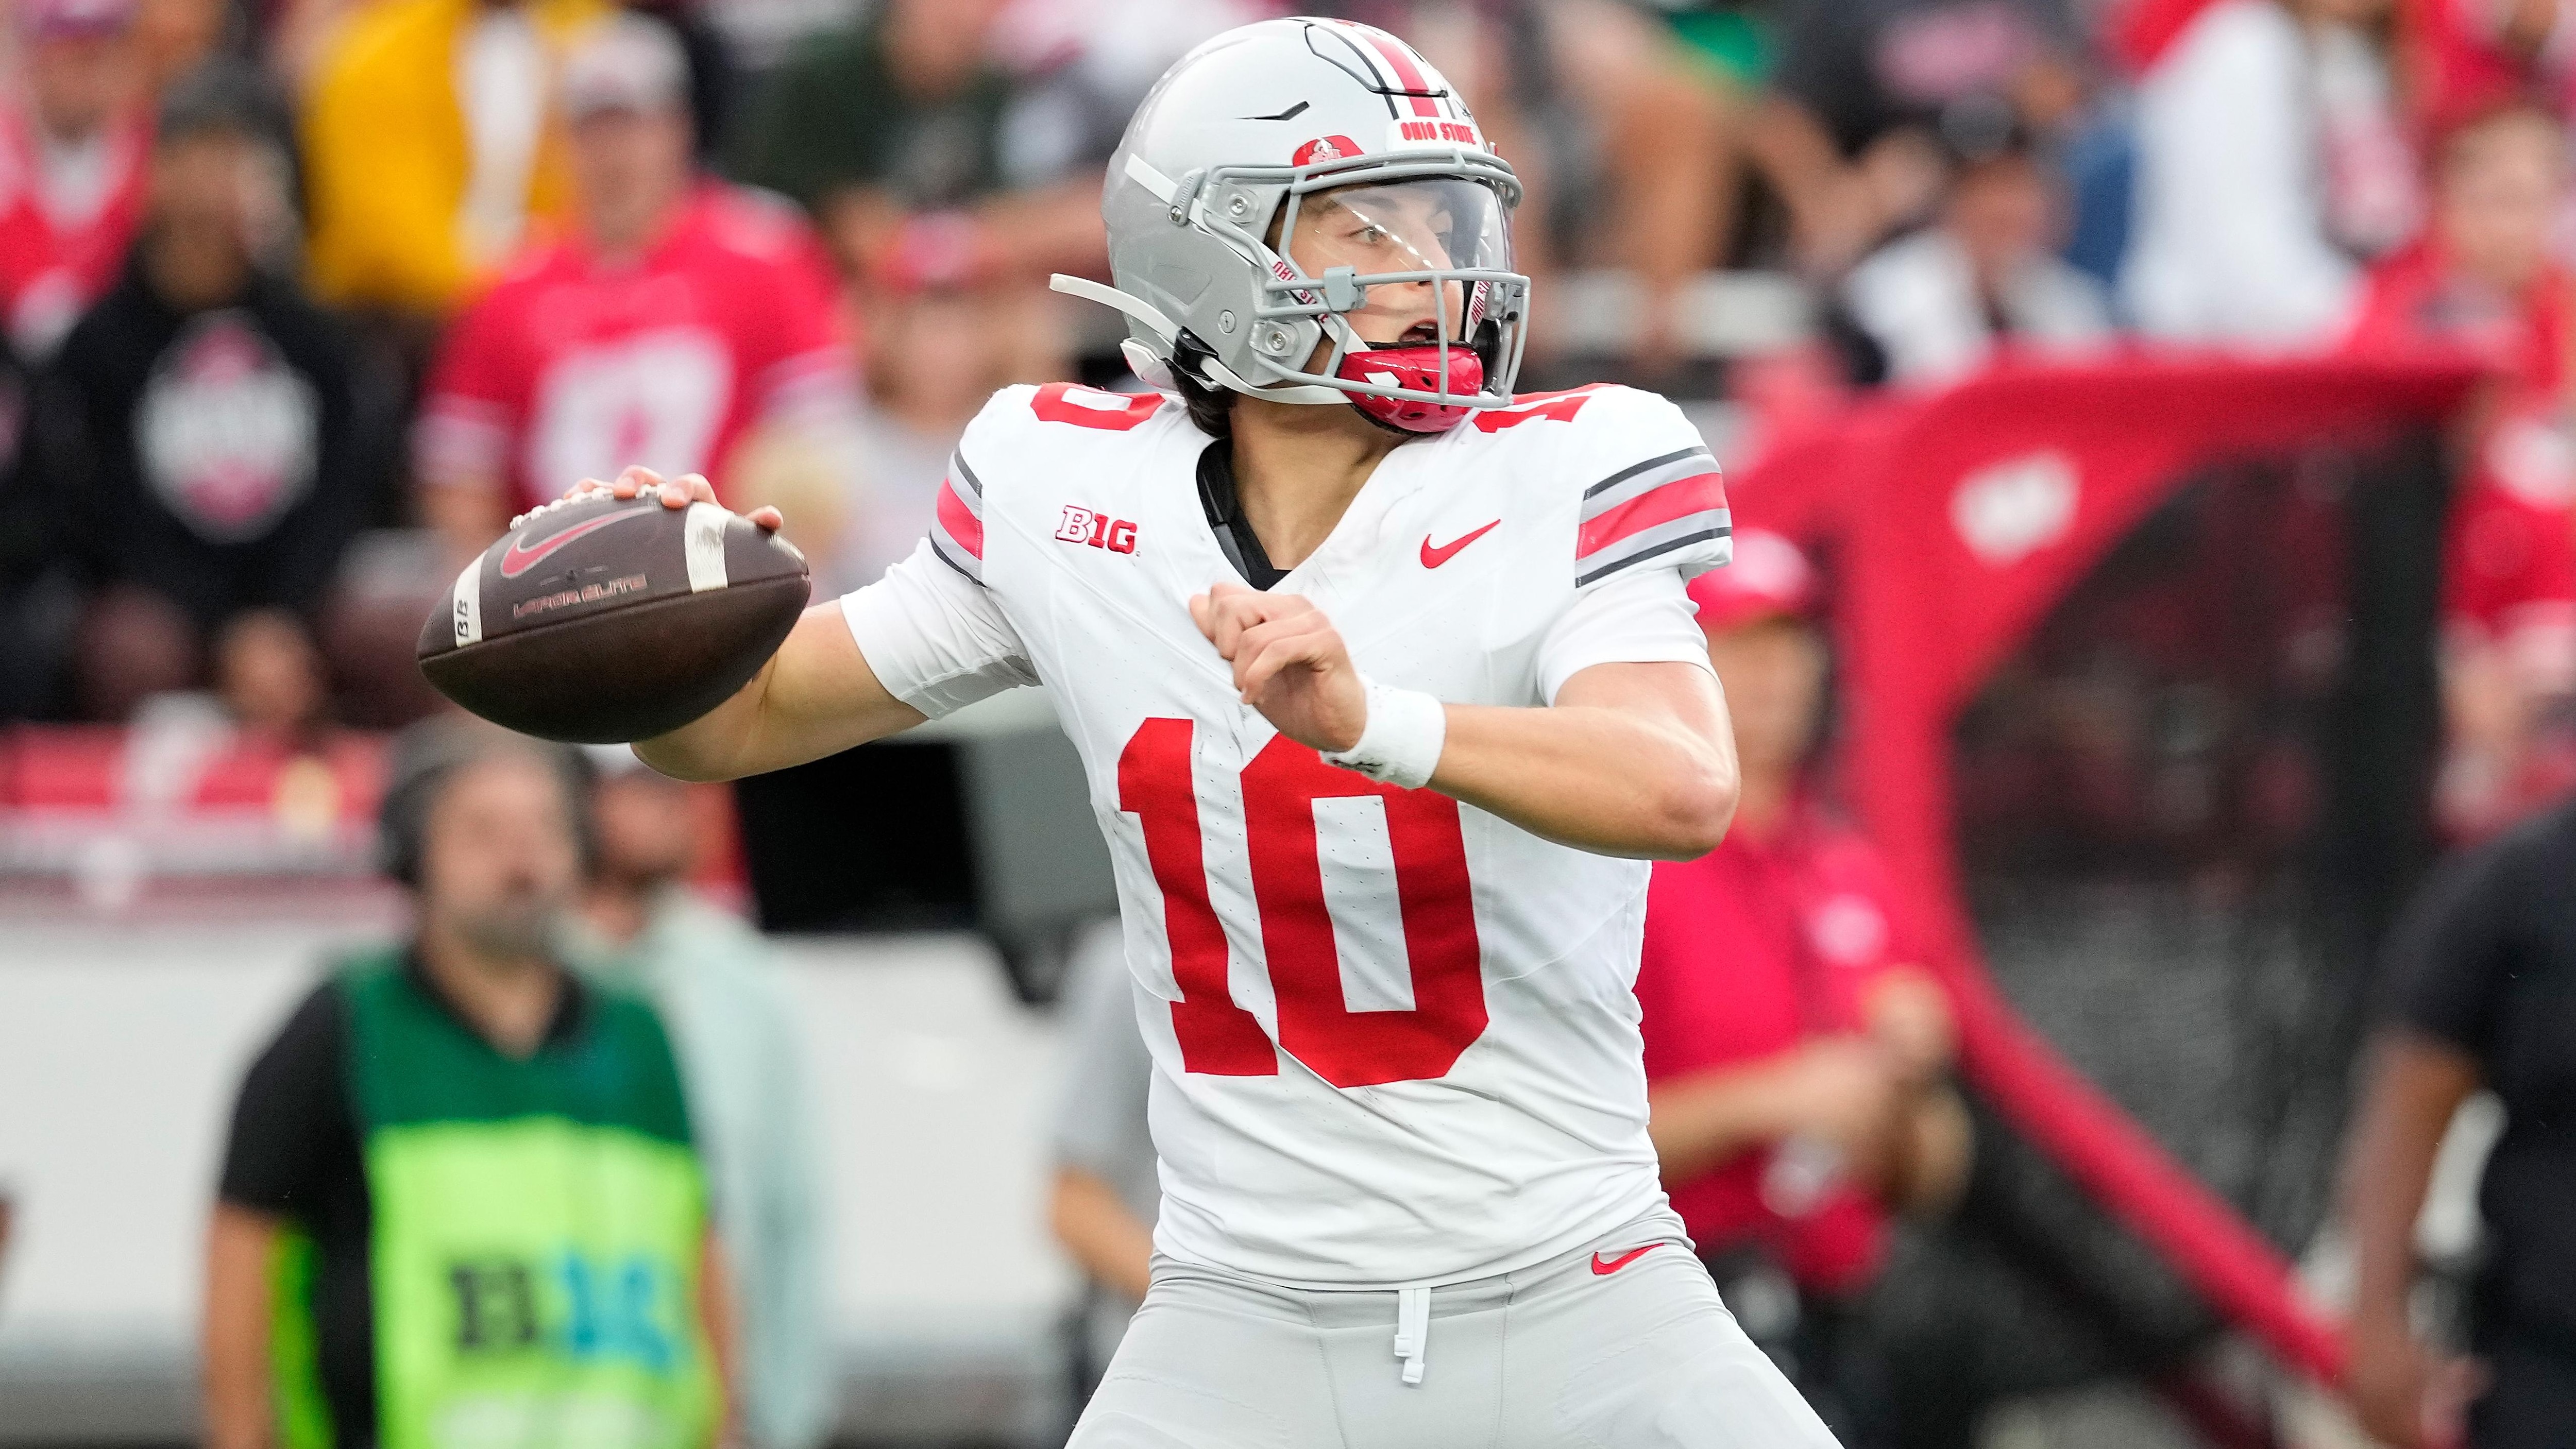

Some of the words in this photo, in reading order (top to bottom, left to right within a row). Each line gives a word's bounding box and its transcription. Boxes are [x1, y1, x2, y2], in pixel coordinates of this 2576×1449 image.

[1400, 122, 1437, 140] OHIO
[1439, 123, 1477, 145] STATE
[1118, 717, 1489, 1088] 10
